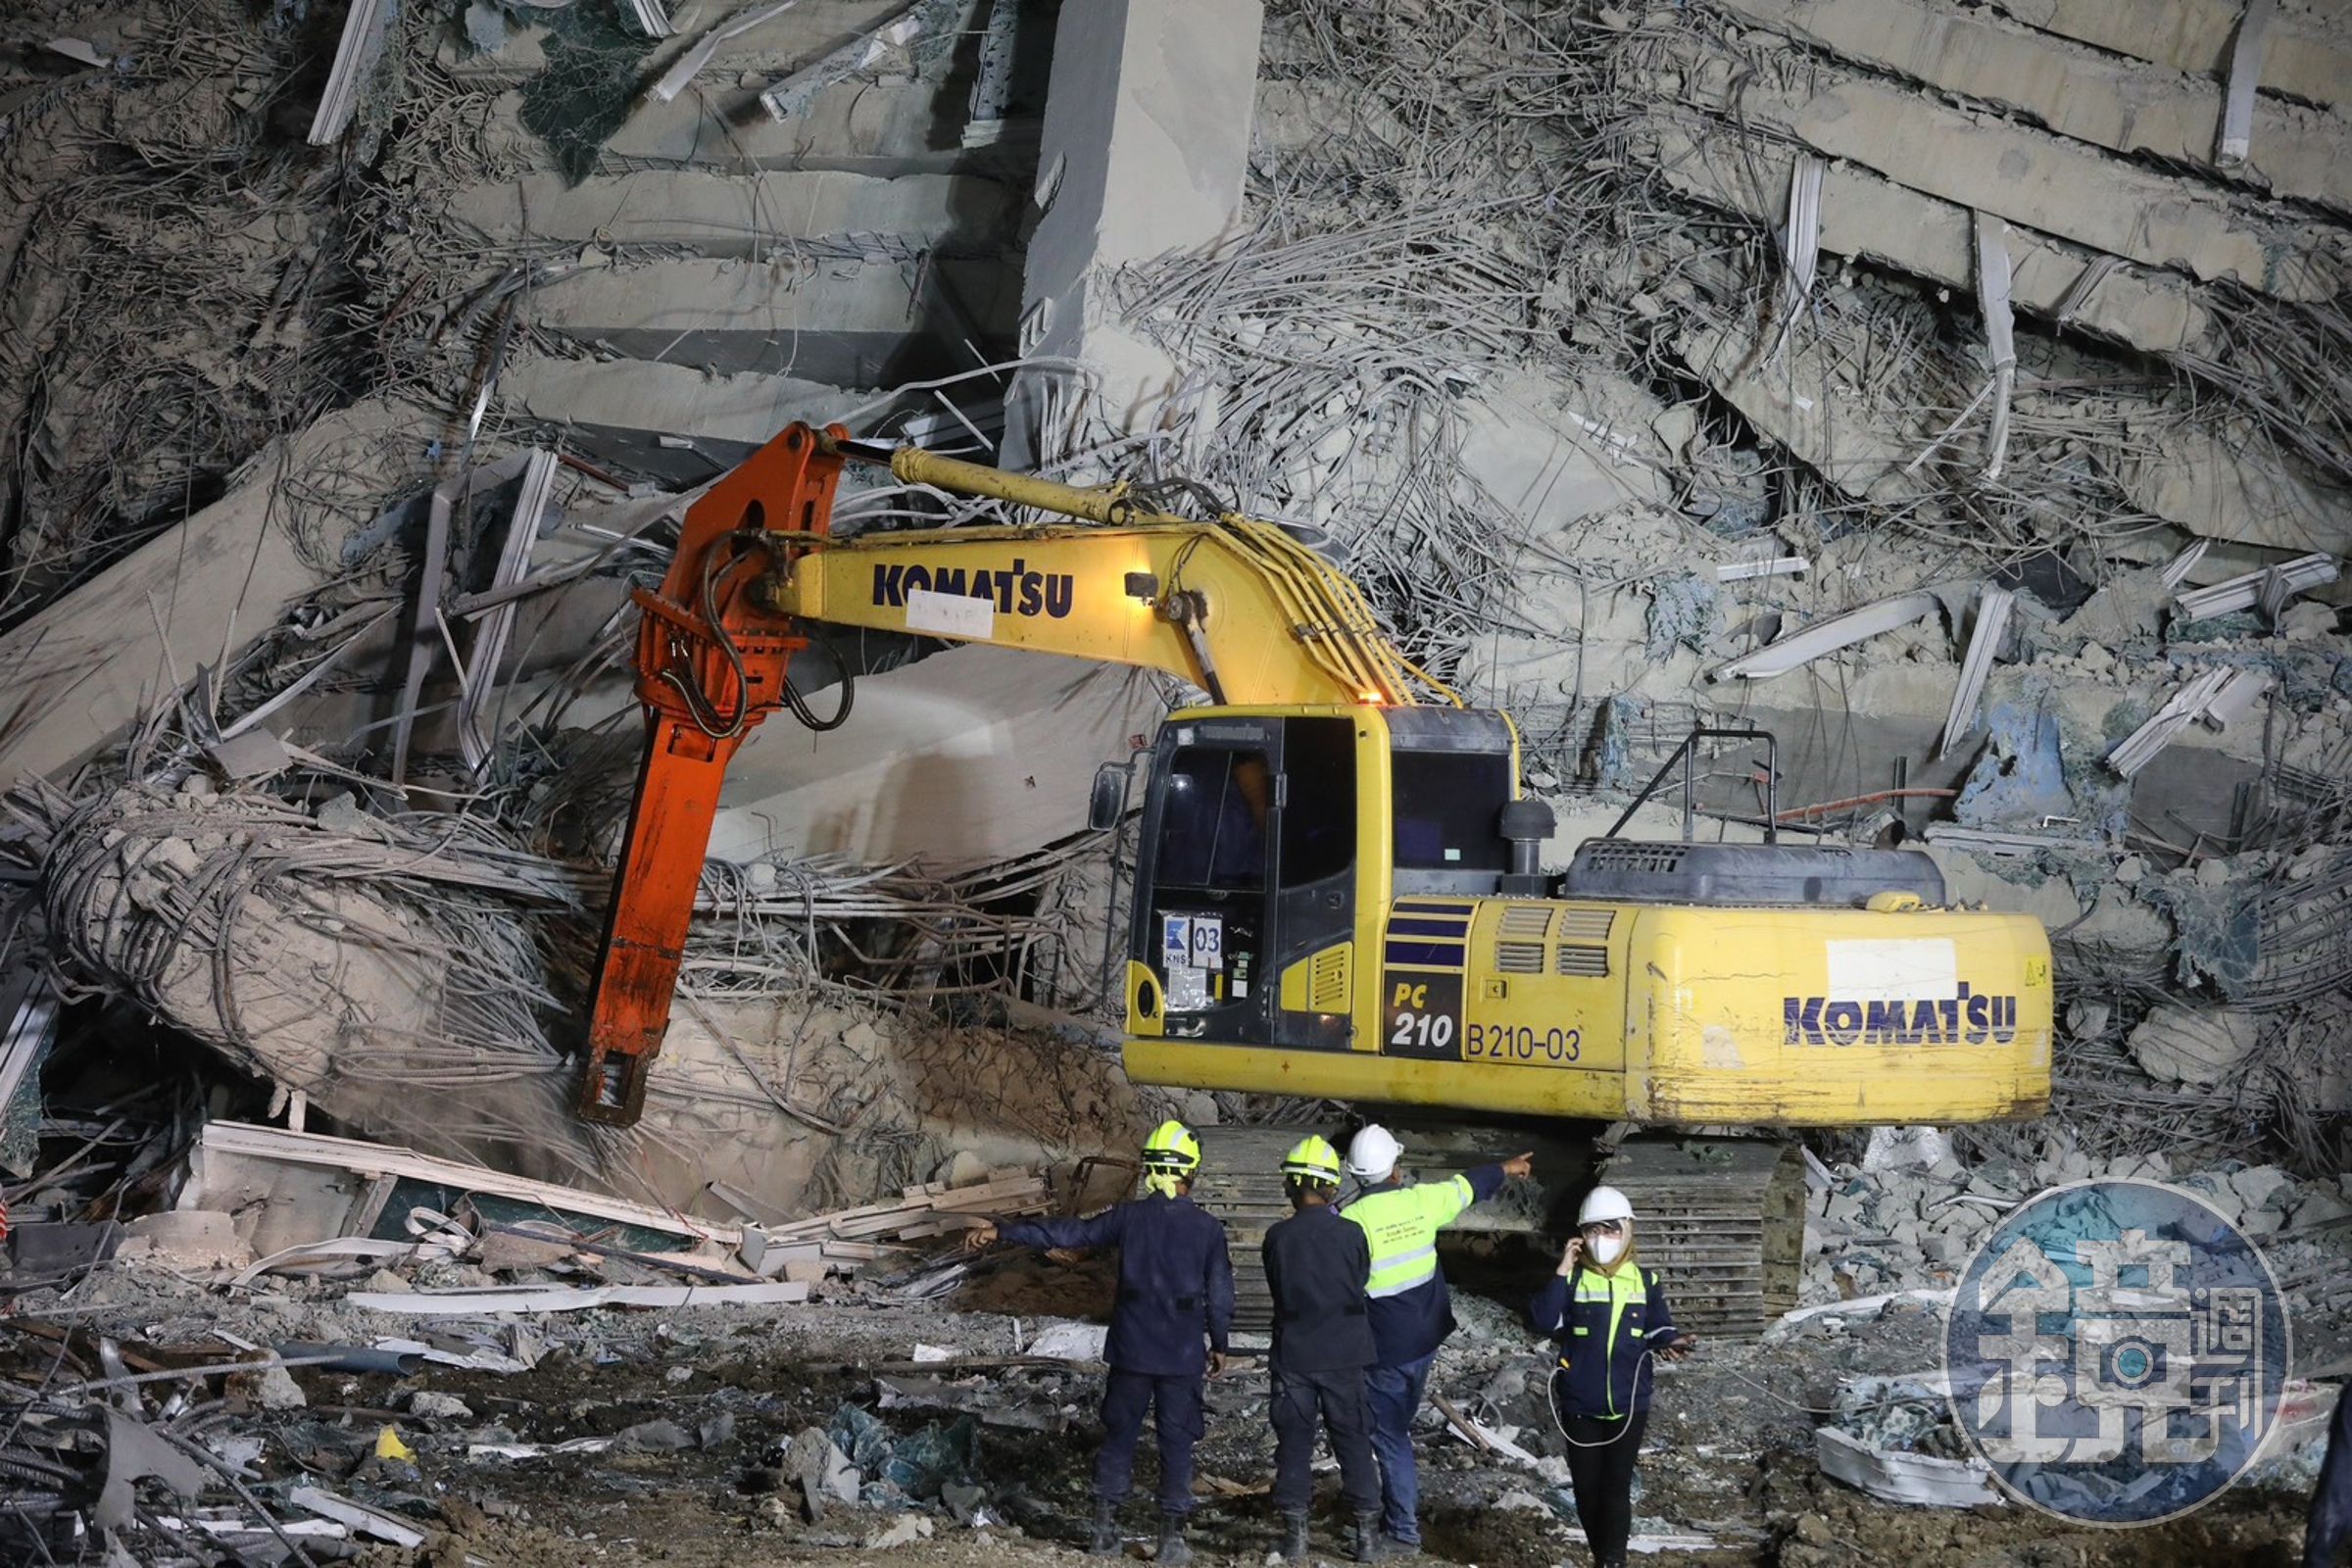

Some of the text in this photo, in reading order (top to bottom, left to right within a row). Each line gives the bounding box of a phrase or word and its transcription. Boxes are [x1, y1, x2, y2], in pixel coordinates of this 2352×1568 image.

[872, 559, 1073, 618] KOMATSU
[1194, 927, 1219, 952] 03
[1394, 982, 1427, 1008] PC
[1391, 1012, 1453, 1048] 210
[1783, 981, 2016, 1046] KOMATSU
